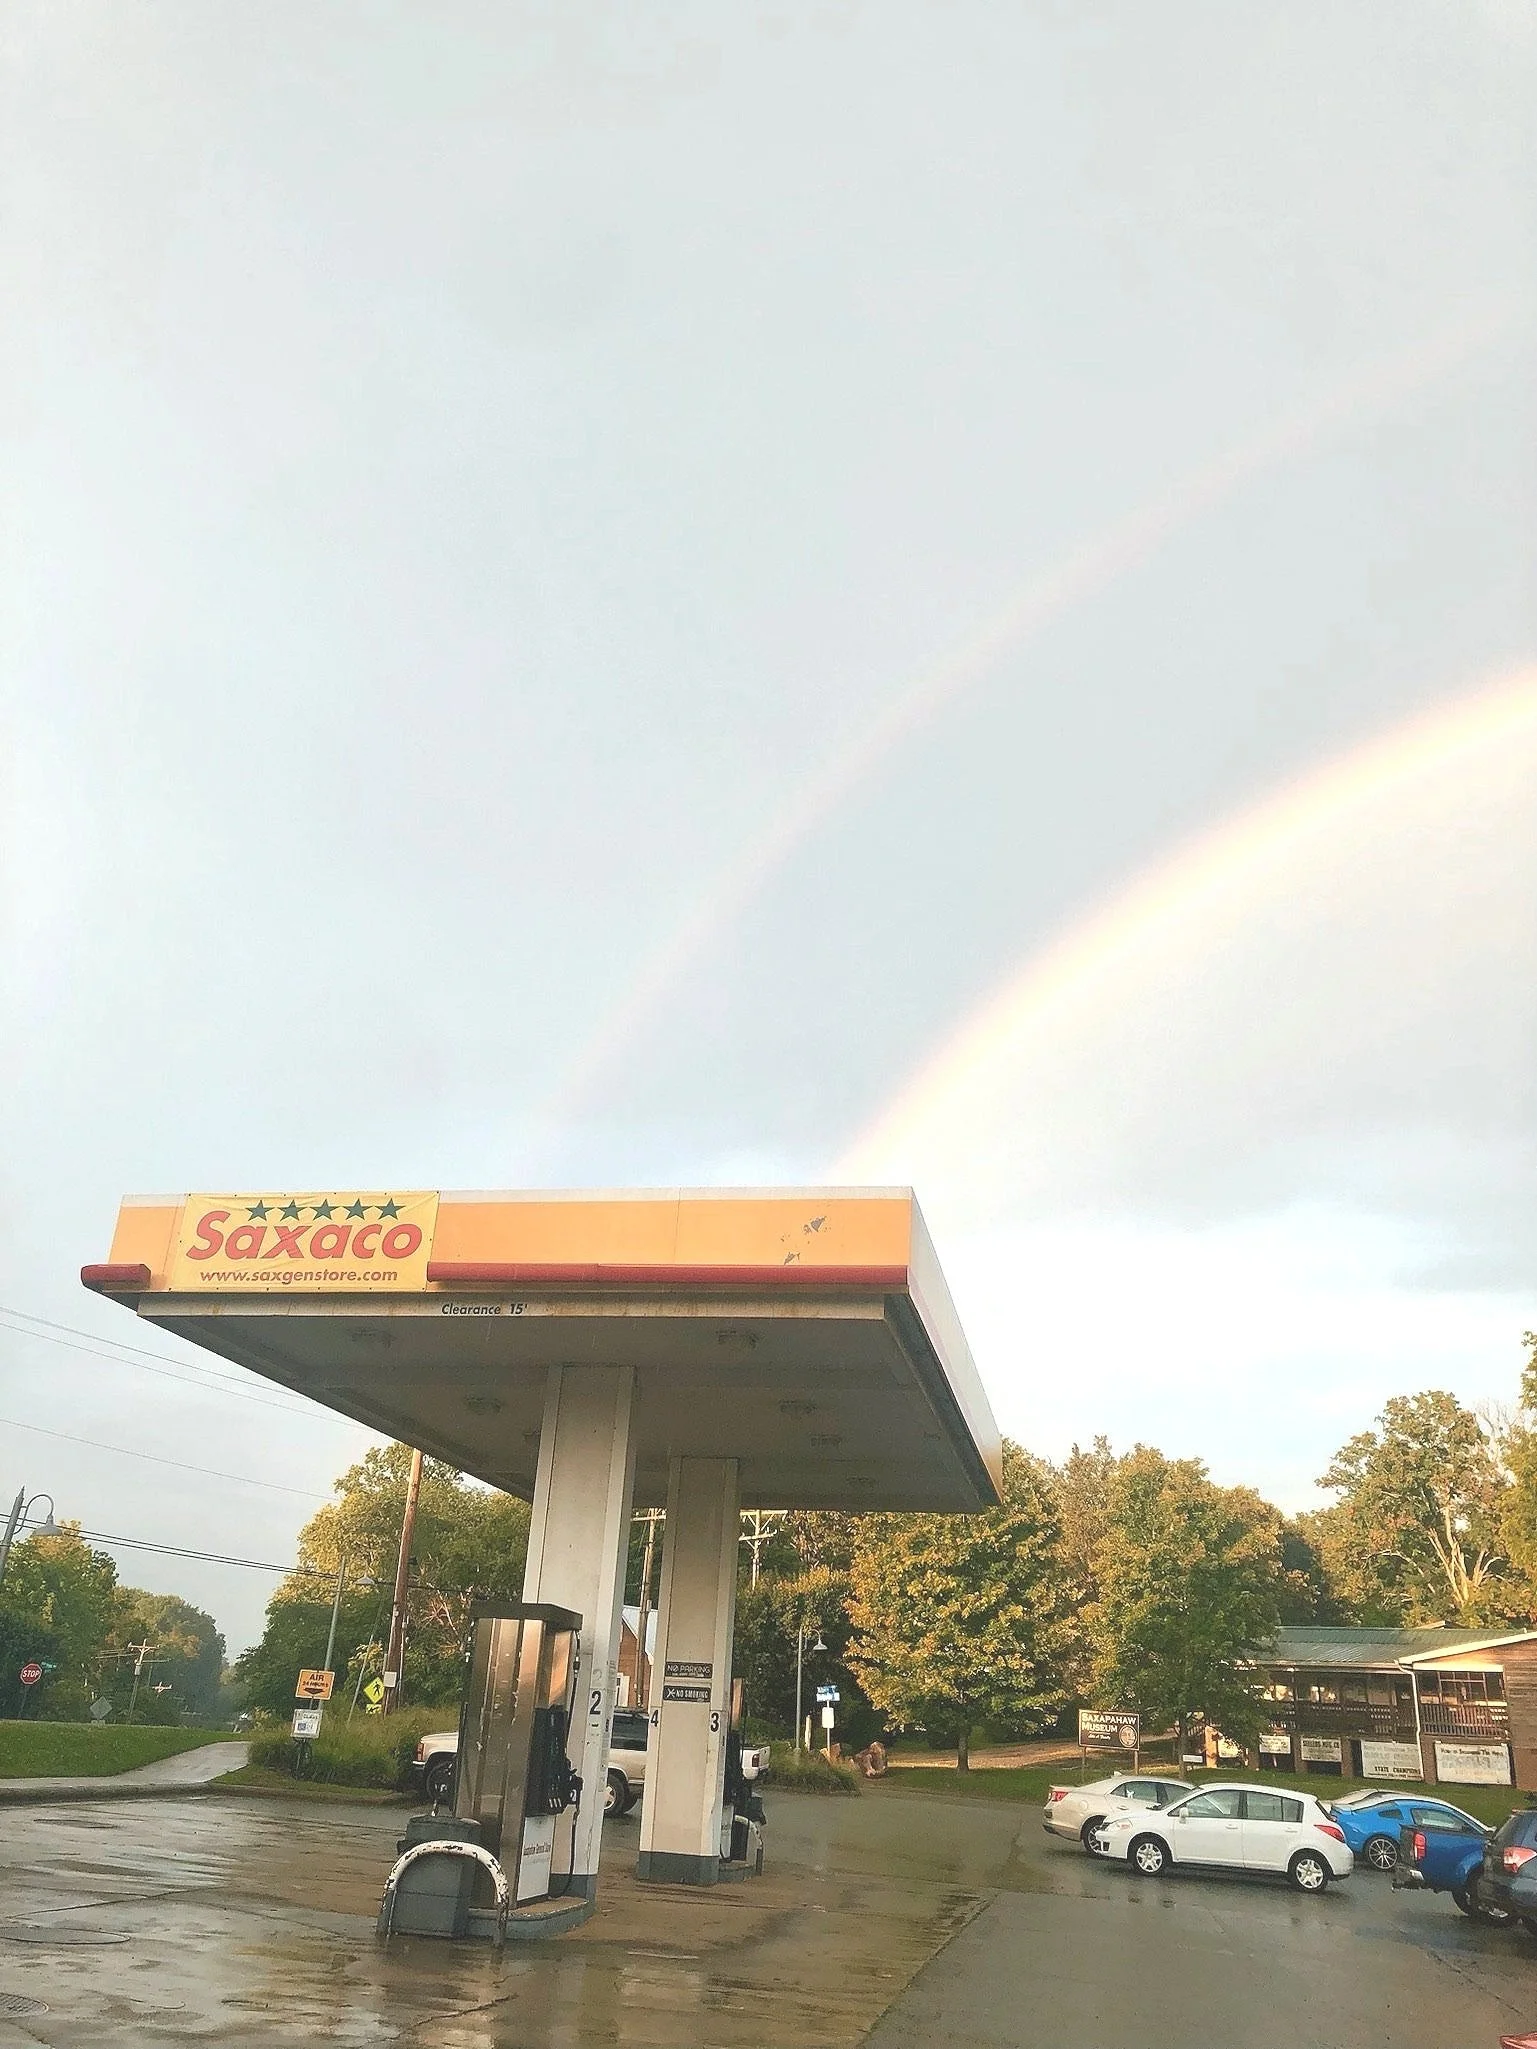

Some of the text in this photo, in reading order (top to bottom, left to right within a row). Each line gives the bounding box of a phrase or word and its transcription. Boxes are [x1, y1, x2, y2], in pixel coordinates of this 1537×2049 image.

[185, 1210, 423, 1260] Saxaco
[199, 1269, 398, 1285] www.saxgenstore.com
[441, 1303, 528, 1315] Clearance 15'
[22, 1669, 40, 1678] STOP
[667, 1664, 711, 1674] NO PARKING
[309, 1673, 325, 1682] AIR
[675, 1689, 709, 1699] NO SMOKING
[590, 1690, 602, 1715] 2
[650, 1709, 659, 1727] 4
[710, 1712, 720, 1733] 3
[1081, 1713, 1137, 1724] SAXAPAHAW
[1081, 1722, 1118, 1733] MUSEUM
